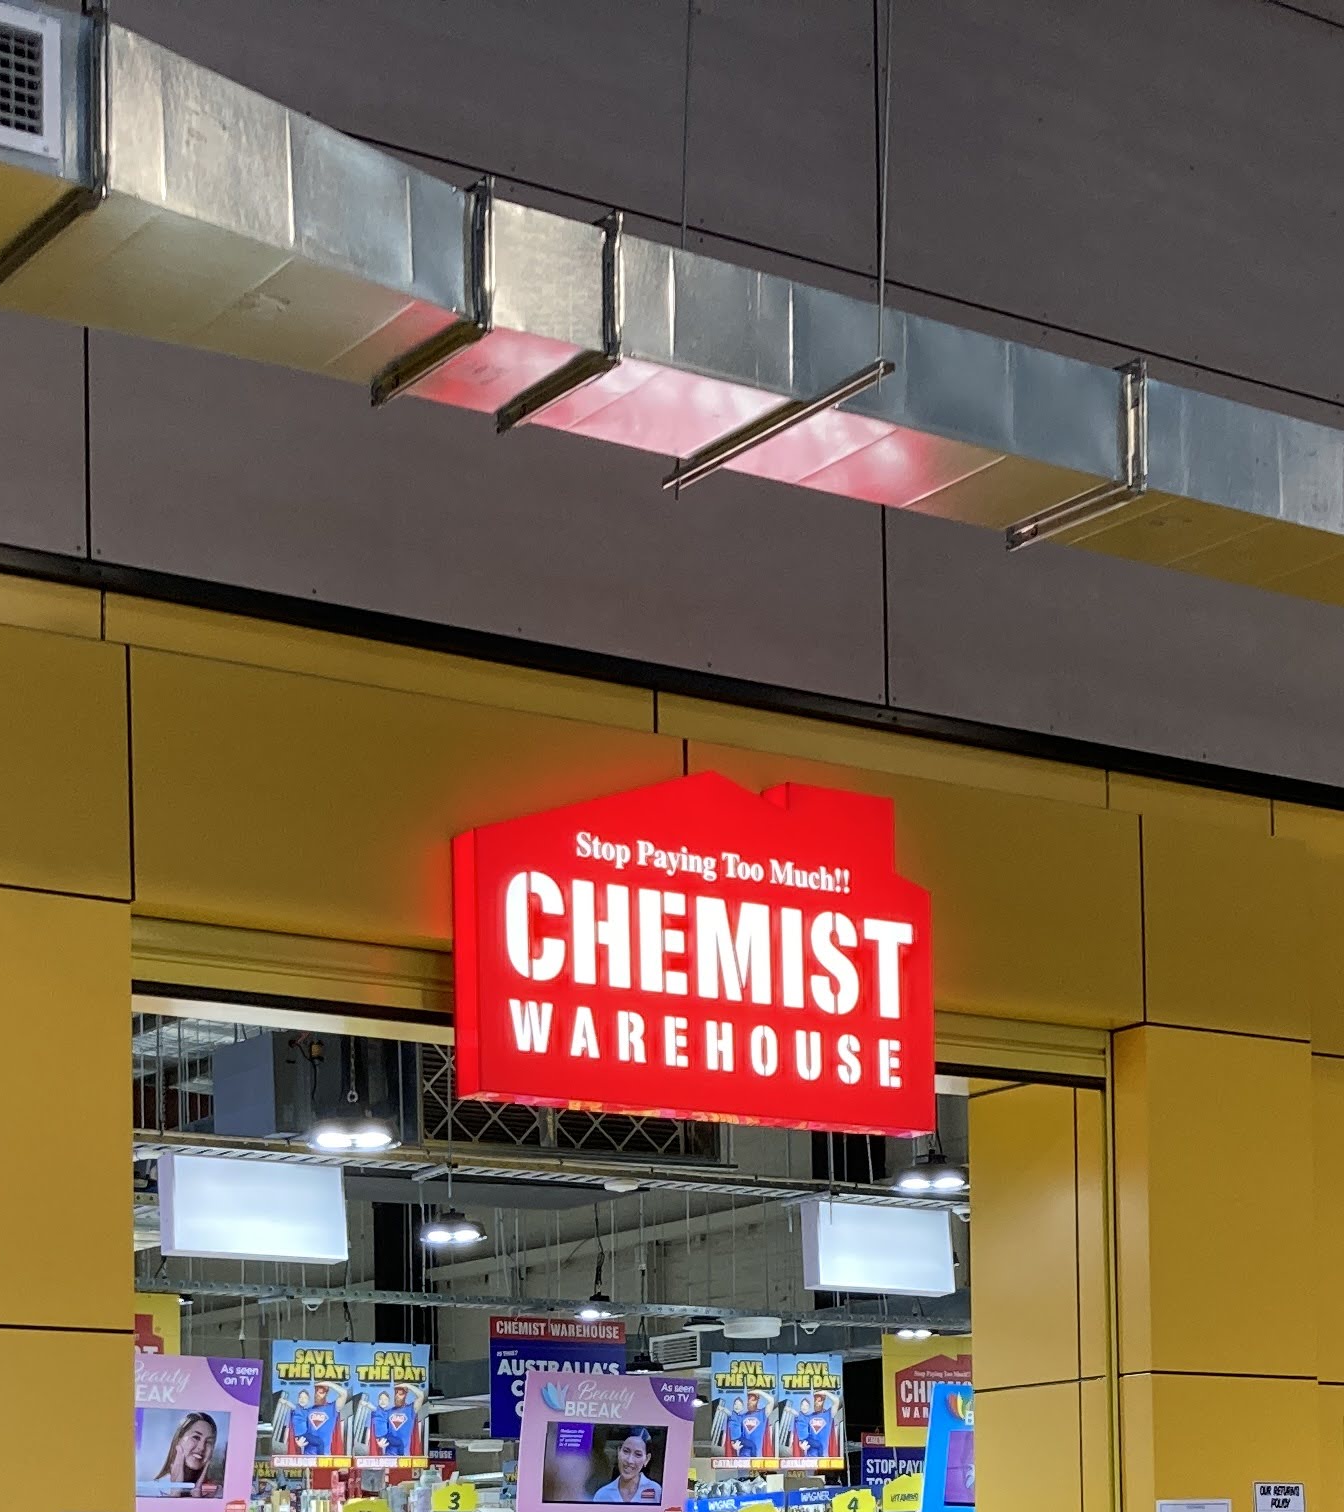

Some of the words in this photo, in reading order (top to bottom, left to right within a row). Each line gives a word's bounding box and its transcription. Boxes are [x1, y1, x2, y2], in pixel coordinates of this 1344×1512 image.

[576, 832, 631, 868] Stop
[637, 839, 717, 881] Paying
[722, 852, 764, 882] Too
[769, 859, 851, 895] Much!!
[505, 870, 913, 1019] CHEMIST
[508, 998, 903, 1088] WAREHOUSE
[496, 1320, 546, 1336] CHEMIST
[550, 1324, 620, 1339] WAREHOUSE
[295, 1349, 334, 1365] SAVE
[375, 1351, 412, 1367] SAVE
[220, 1364, 234, 1375] As
[236, 1366, 259, 1376] seen
[277, 1363, 312, 1379] THE
[314, 1365, 350, 1380] DAY!
[356, 1365, 390, 1381] THE
[393, 1366, 426, 1382] DAY!
[731, 1361, 763, 1374] SAVE
[797, 1362, 829, 1375] SAVE
[224, 1377, 238, 1386] on
[240, 1376, 254, 1387] TV
[660, 1382, 673, 1393] As
[674, 1384, 695, 1394] seen
[715, 1374, 745, 1388] THE
[747, 1374, 776, 1388] DAY!
[782, 1375, 812, 1389] THE
[813, 1375, 841, 1389] DAY!
[577, 1380, 636, 1410] Beauty
[663, 1394, 676, 1403] on
[677, 1394, 689, 1403] TV
[564, 1400, 622, 1419] BREAK
[866, 1458, 897, 1475] STOP
[800, 1491, 831, 1502] WAGNER
[1259, 1486, 1272, 1496] OUR
[447, 1491, 460, 1511] 3
